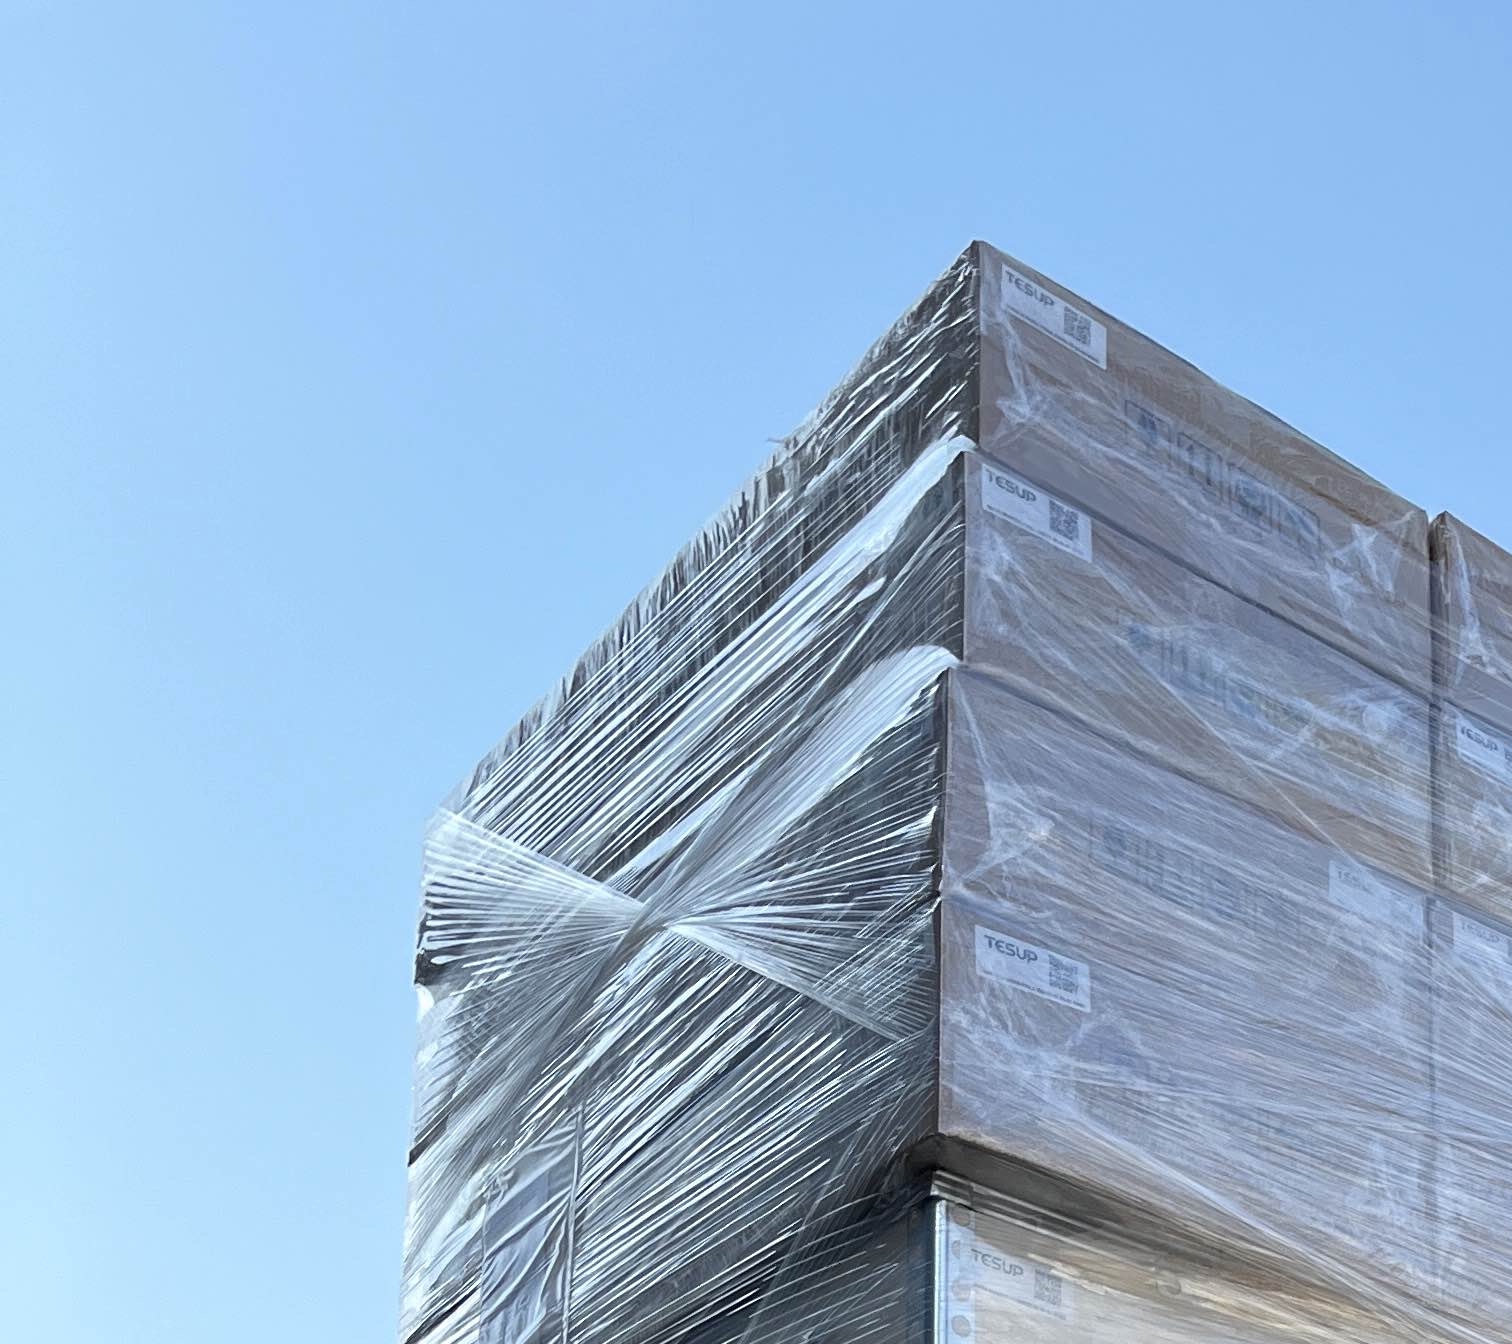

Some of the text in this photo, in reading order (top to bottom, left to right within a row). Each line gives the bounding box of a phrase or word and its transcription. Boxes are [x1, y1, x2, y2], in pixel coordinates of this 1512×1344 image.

[1005, 270, 1055, 306] TESUP
[986, 469, 1036, 502] TESUP
[984, 935, 1038, 964] TESUP
[971, 1248, 1024, 1276] TESUP
